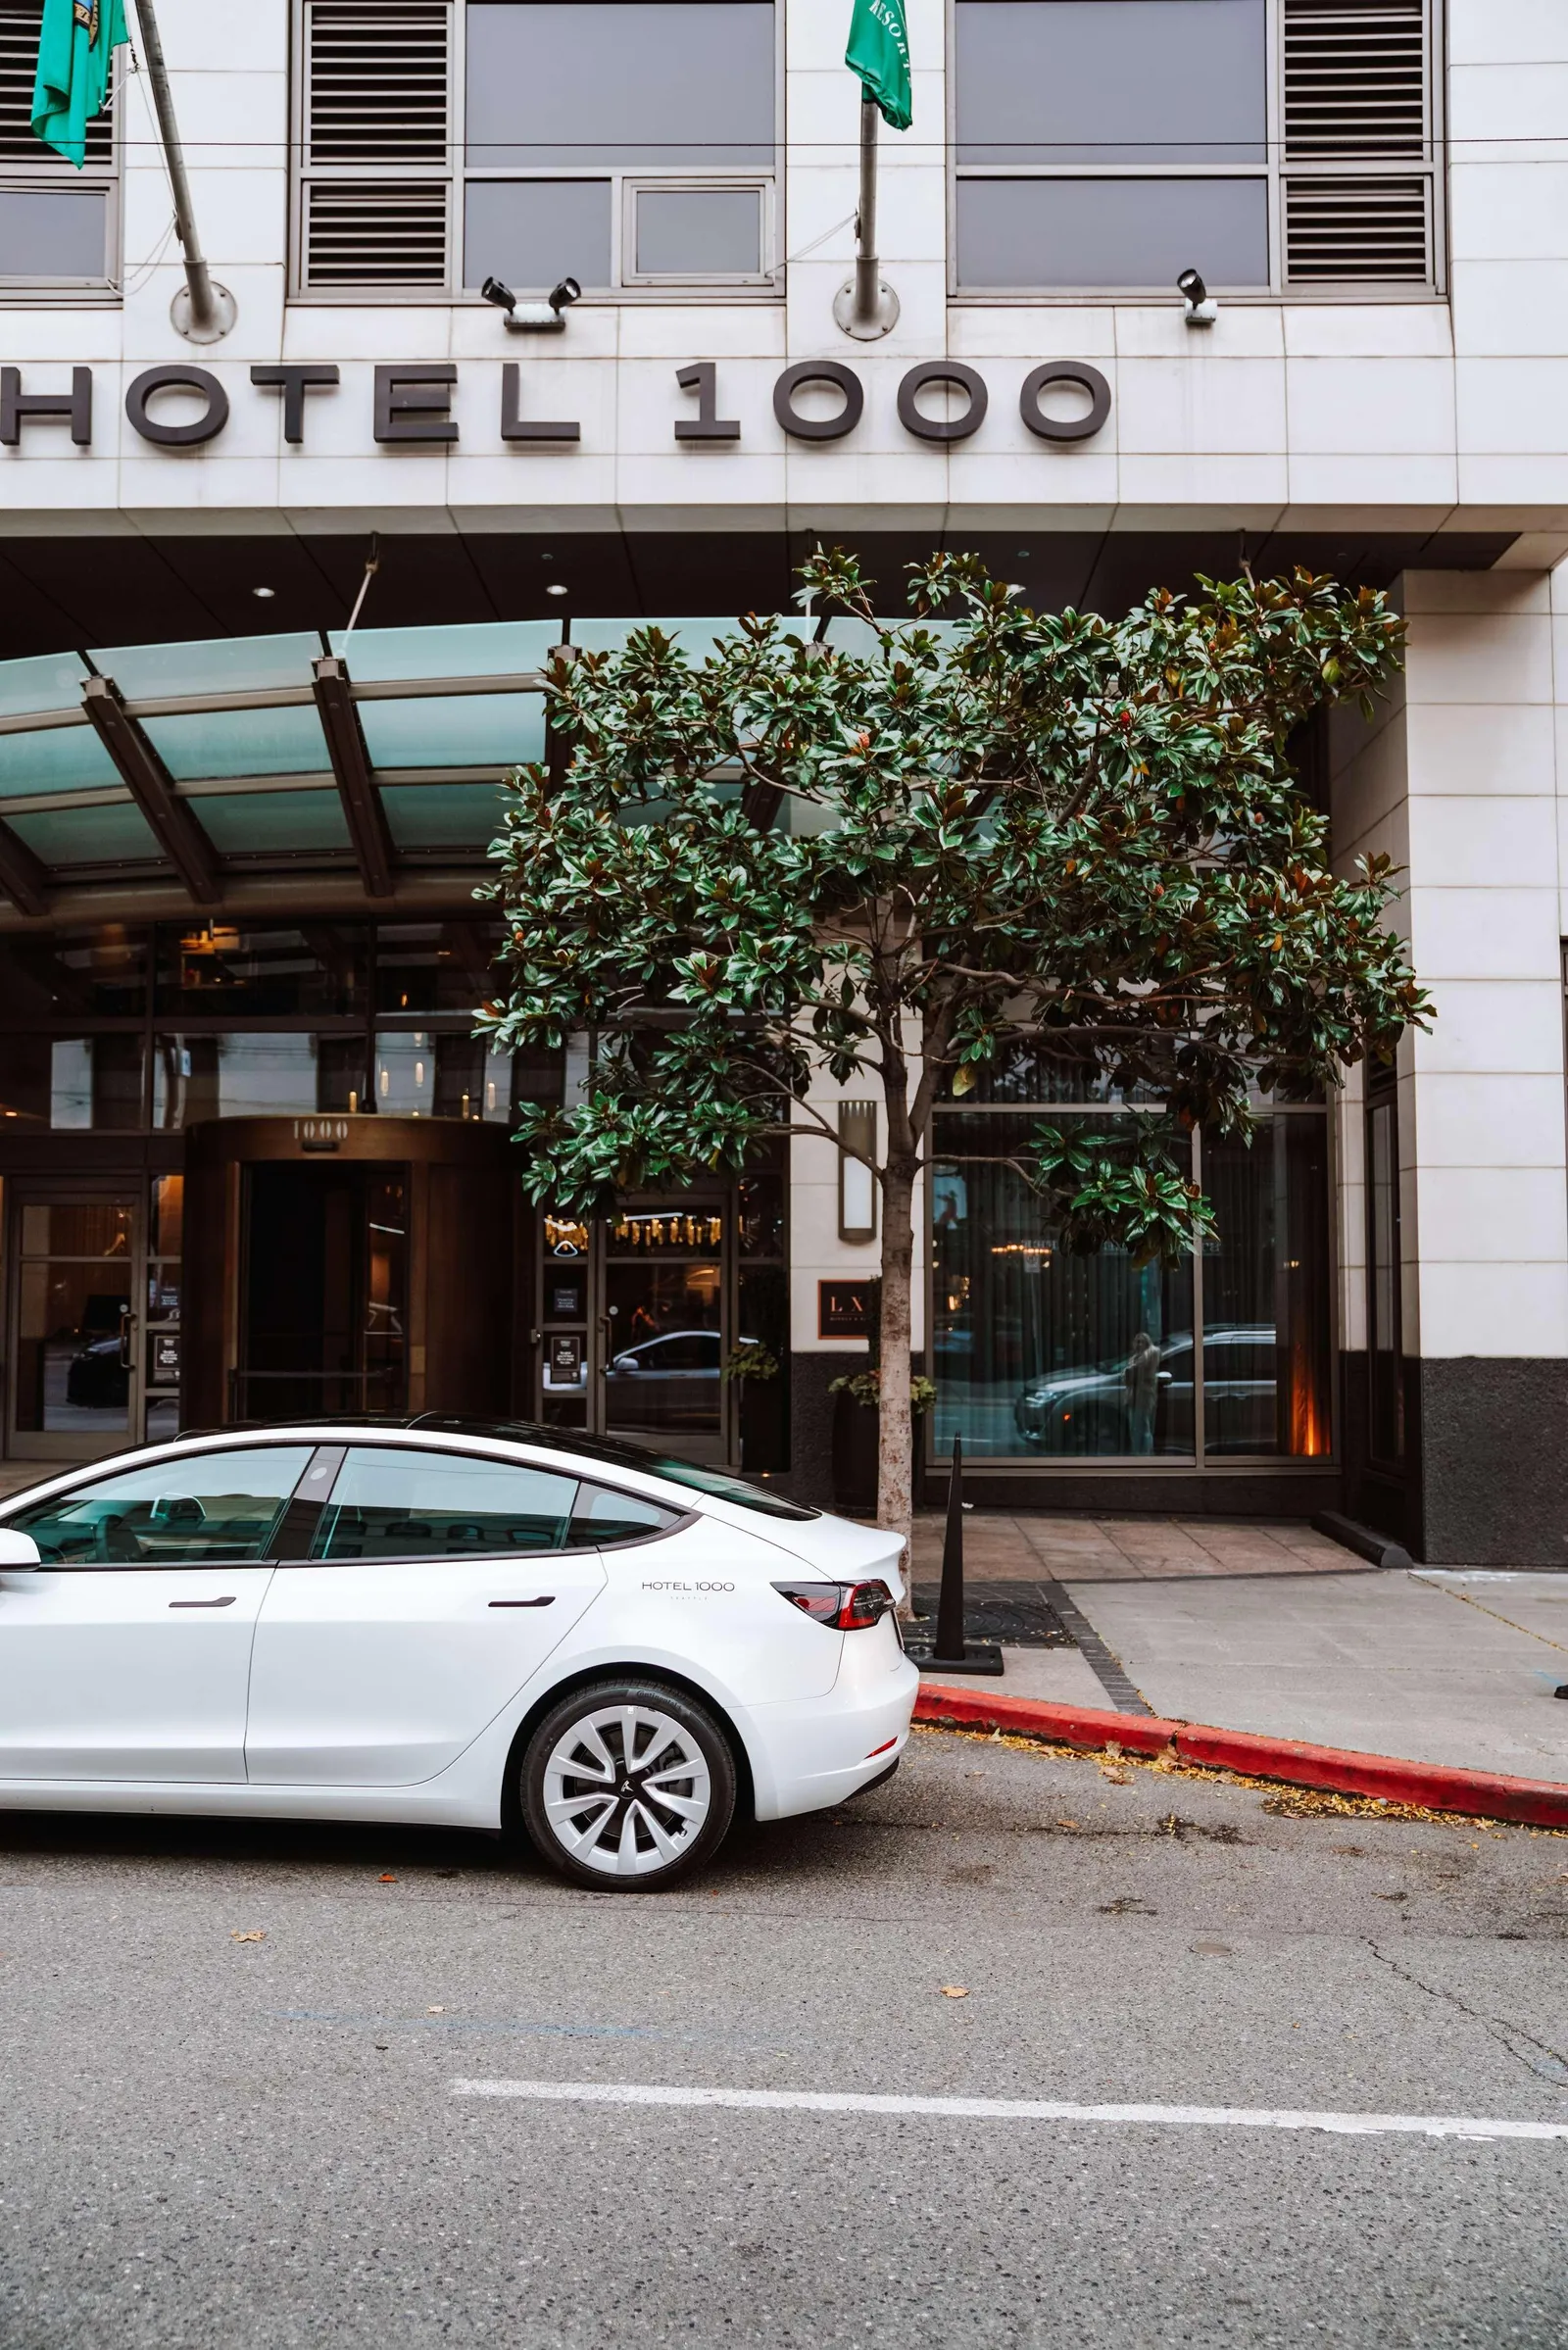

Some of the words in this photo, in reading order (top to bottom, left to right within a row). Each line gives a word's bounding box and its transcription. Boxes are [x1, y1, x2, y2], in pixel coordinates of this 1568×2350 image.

[0, 363, 580, 446] HOTEL
[674, 360, 1110, 442] 1000
[294, 1120, 348, 1139] 1000
[642, 1581, 692, 1591] HOTEL
[695, 1581, 735, 1591] 1000
